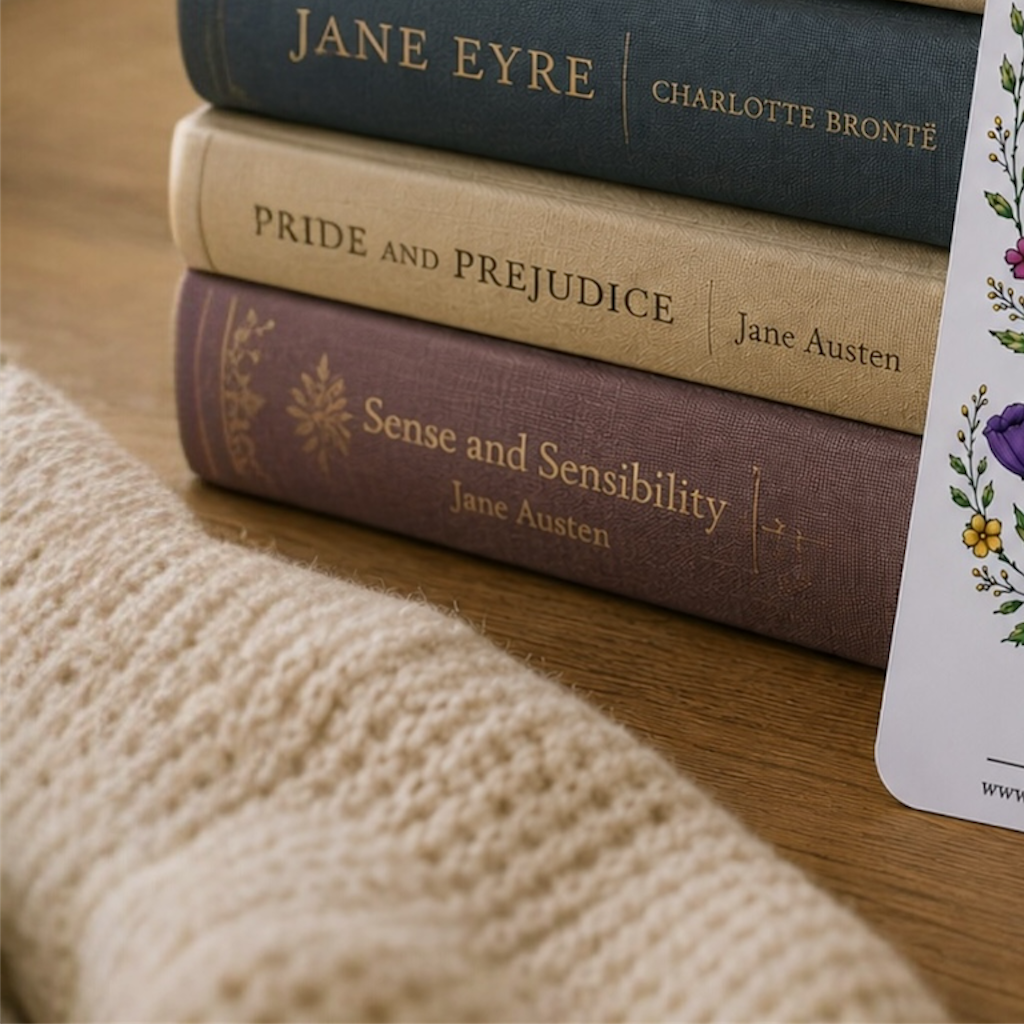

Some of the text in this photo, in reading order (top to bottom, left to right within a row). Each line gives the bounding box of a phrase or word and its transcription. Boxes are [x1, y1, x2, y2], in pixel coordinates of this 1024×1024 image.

[288, 7, 596, 100] JANE EYRE
[651, 79, 938, 152] CHARLOTTE BRONTË
[253, 204, 675, 325] PRIDE AND PREJUDICE
[734, 311, 902, 373] Jane Austen
[362, 397, 730, 535] Sense and Sensibility
[450, 480, 611, 549] Jane Austen
